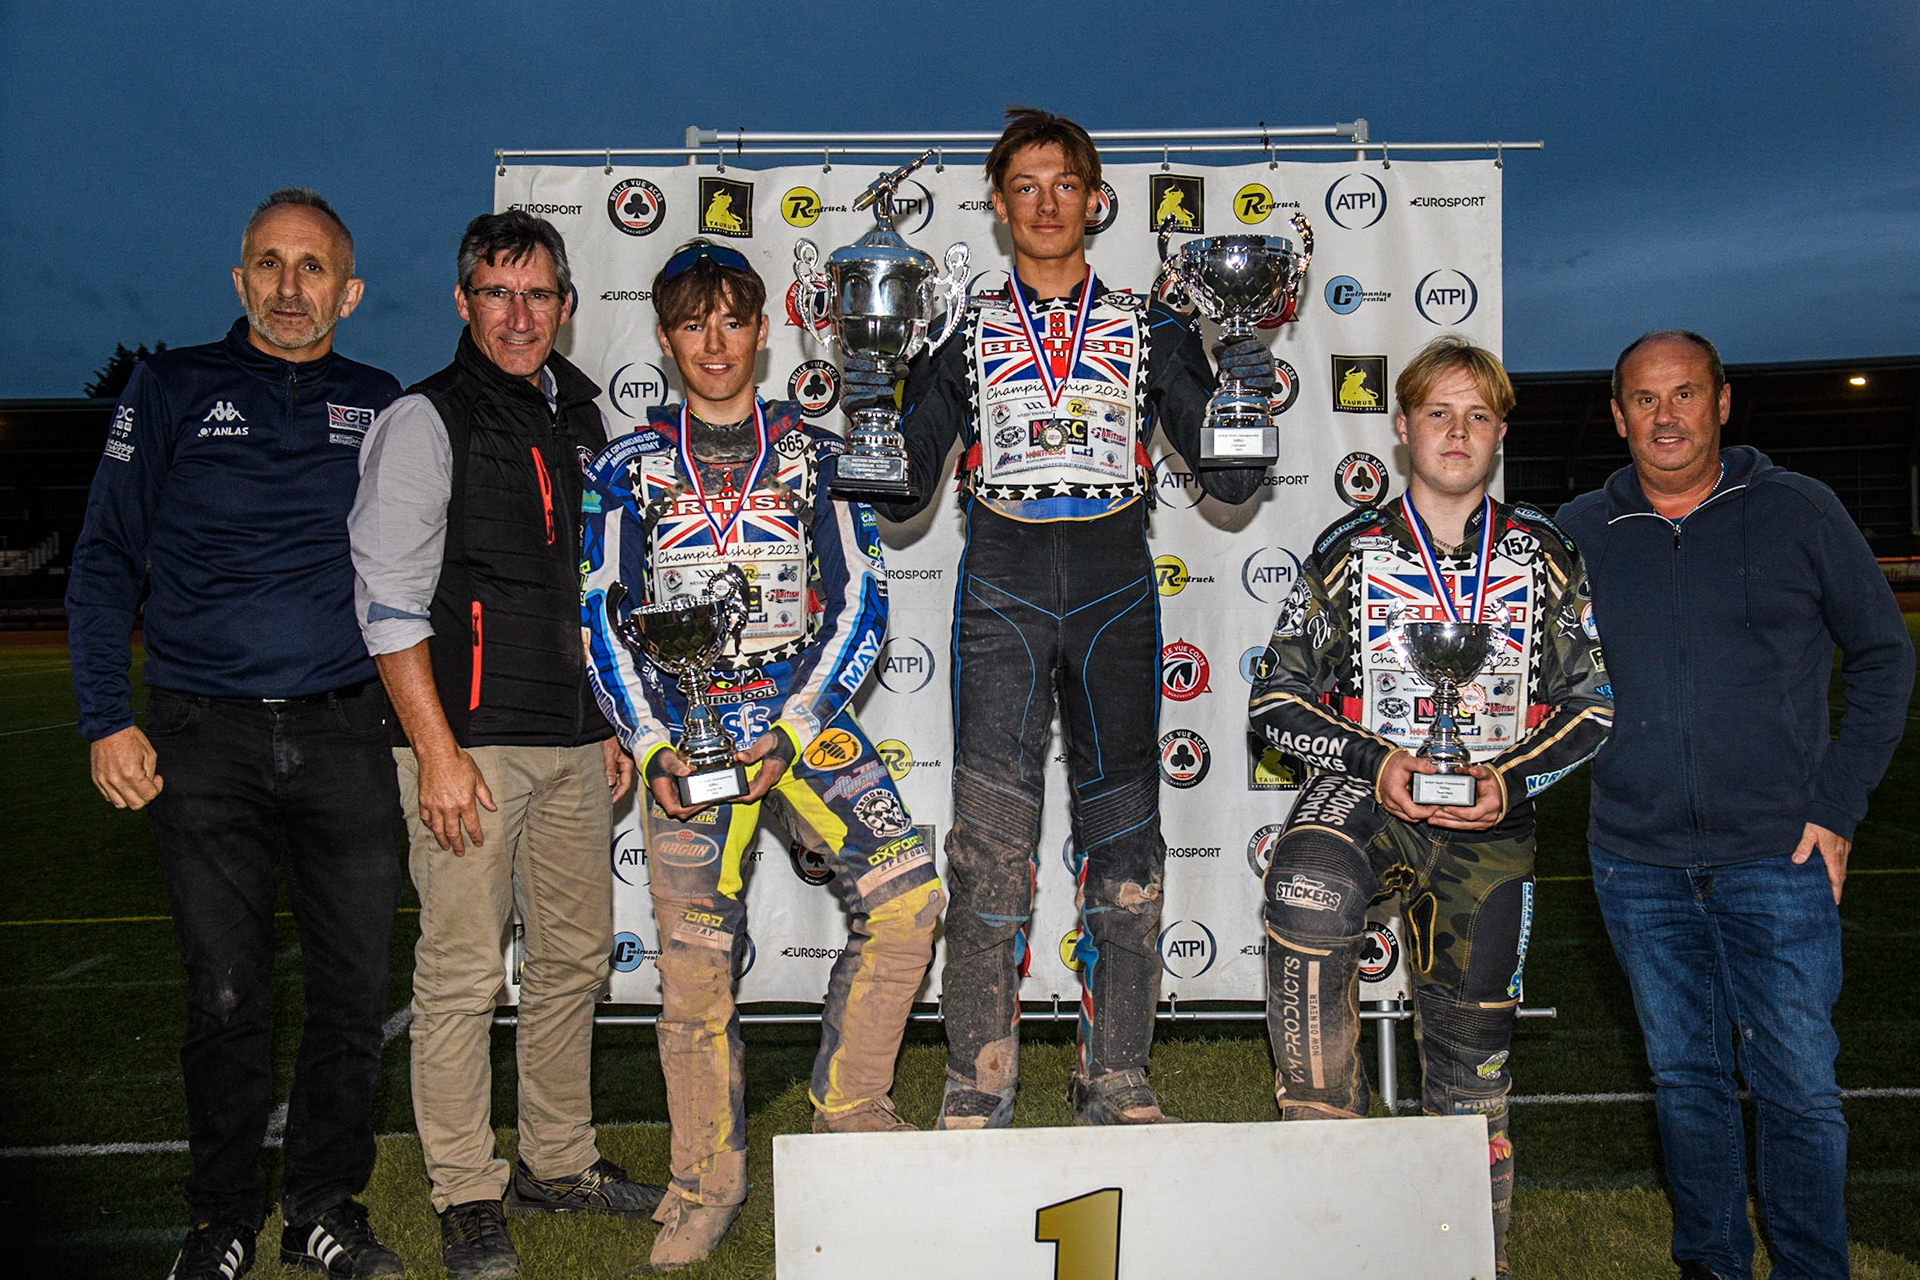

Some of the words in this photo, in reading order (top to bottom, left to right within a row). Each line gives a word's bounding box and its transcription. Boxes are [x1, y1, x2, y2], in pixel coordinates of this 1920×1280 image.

[609, 180, 628, 202] BELLE
[630, 180, 647, 188] VUE
[648, 184, 664, 203] ACES
[1101, 182, 1116, 202] ACES
[507, 203, 582, 215] EUROSPORT
[788, 196, 847, 218] Rentruck
[1241, 193, 1300, 216] Rentruck
[1335, 193, 1375, 210] ATPI
[1409, 197, 1485, 208] EUROSPORT
[709, 220, 737, 230] TAURUS
[1107, 294, 1134, 306] 522
[1425, 289, 1465, 305] ATPI
[789, 365, 807, 385] BELLE
[810, 361, 824, 369] VUE
[825, 364, 839, 382] ACES
[1281, 363, 1297, 381] ACES
[619, 382, 658, 398] ATPI
[1094, 384, 1128, 400] 2023
[343, 408, 373, 426] GB
[212, 426, 249, 437] ANLAS
[638, 441, 661, 452] ARMY
[778, 434, 804, 452] 665
[1337, 454, 1355, 476] BELLE
[1356, 453, 1370, 461] VUE
[1371, 460, 1387, 477] ACES
[1161, 472, 1199, 489] ATPI
[767, 545, 800, 556] 2023
[1502, 535, 1536, 556] 152
[1154, 565, 1215, 587] Rentruck
[1252, 567, 1292, 584] ATPI
[883, 656, 923, 673] ATPI
[1173, 645, 1188, 653] VUE
[1189, 648, 1206, 667] COLTS
[1176, 731, 1192, 739] VUE
[1193, 735, 1208, 754] ACES
[1265, 725, 1348, 757] HAGON
[879, 749, 942, 771] Rentruck
[1295, 775, 1346, 824] HAGON
[1250, 828, 1269, 849] BELLE
[1166, 848, 1221, 858] ROSPORT
[1277, 883, 1340, 907] STICKERS
[1381, 929, 1397, 947] ACES
[1167, 940, 1205, 957] ATPI
[1309, 994, 1318, 1021] NEVER
[1310, 1024, 1319, 1035] OR
[1311, 1038, 1322, 1056] NOW
[1034, 1187, 1123, 1280] 1
